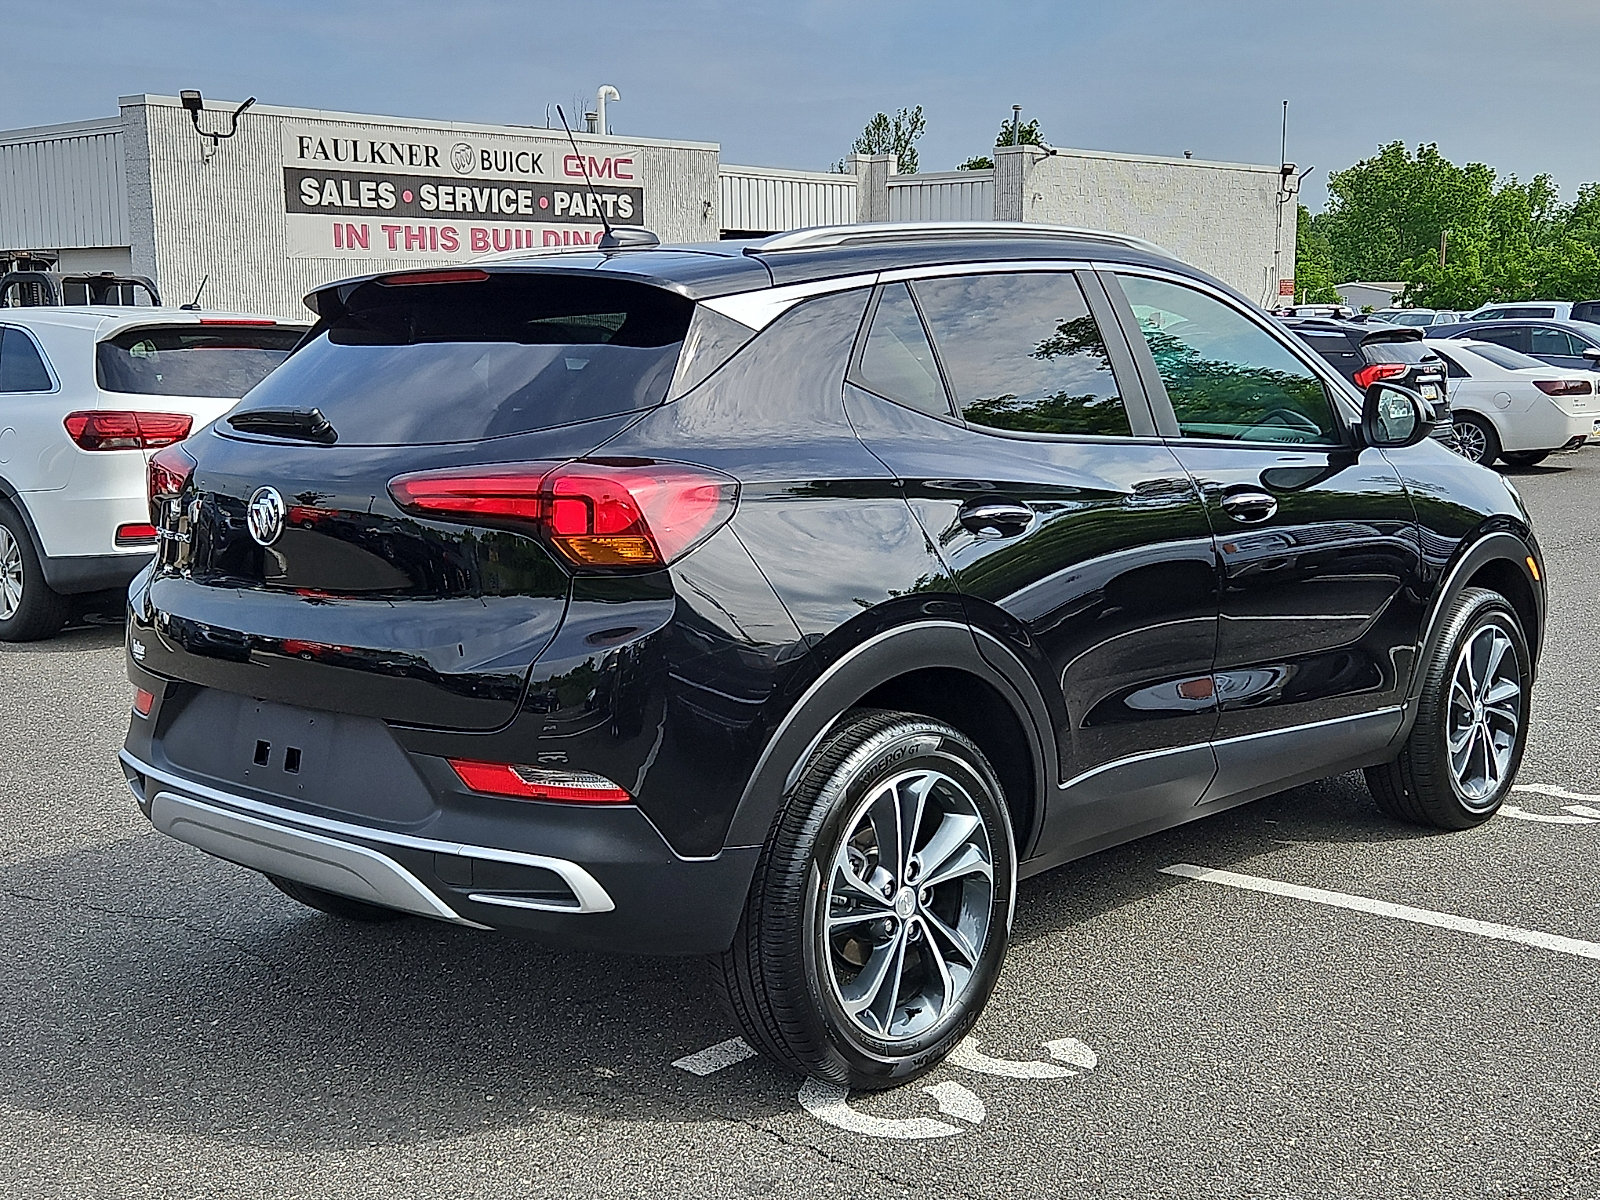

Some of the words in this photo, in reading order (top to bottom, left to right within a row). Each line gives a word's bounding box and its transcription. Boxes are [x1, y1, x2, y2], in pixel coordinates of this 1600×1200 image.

[296, 135, 441, 167] FAULKNER
[480, 149, 544, 175] BUICK
[563, 154, 634, 180] GMC
[299, 176, 396, 210] SALES
[418, 182, 534, 215] SERVICE
[553, 190, 634, 219] PARTS
[332, 222, 371, 250] IN
[381, 224, 460, 253] THIS
[908, 743, 921, 755] GT
